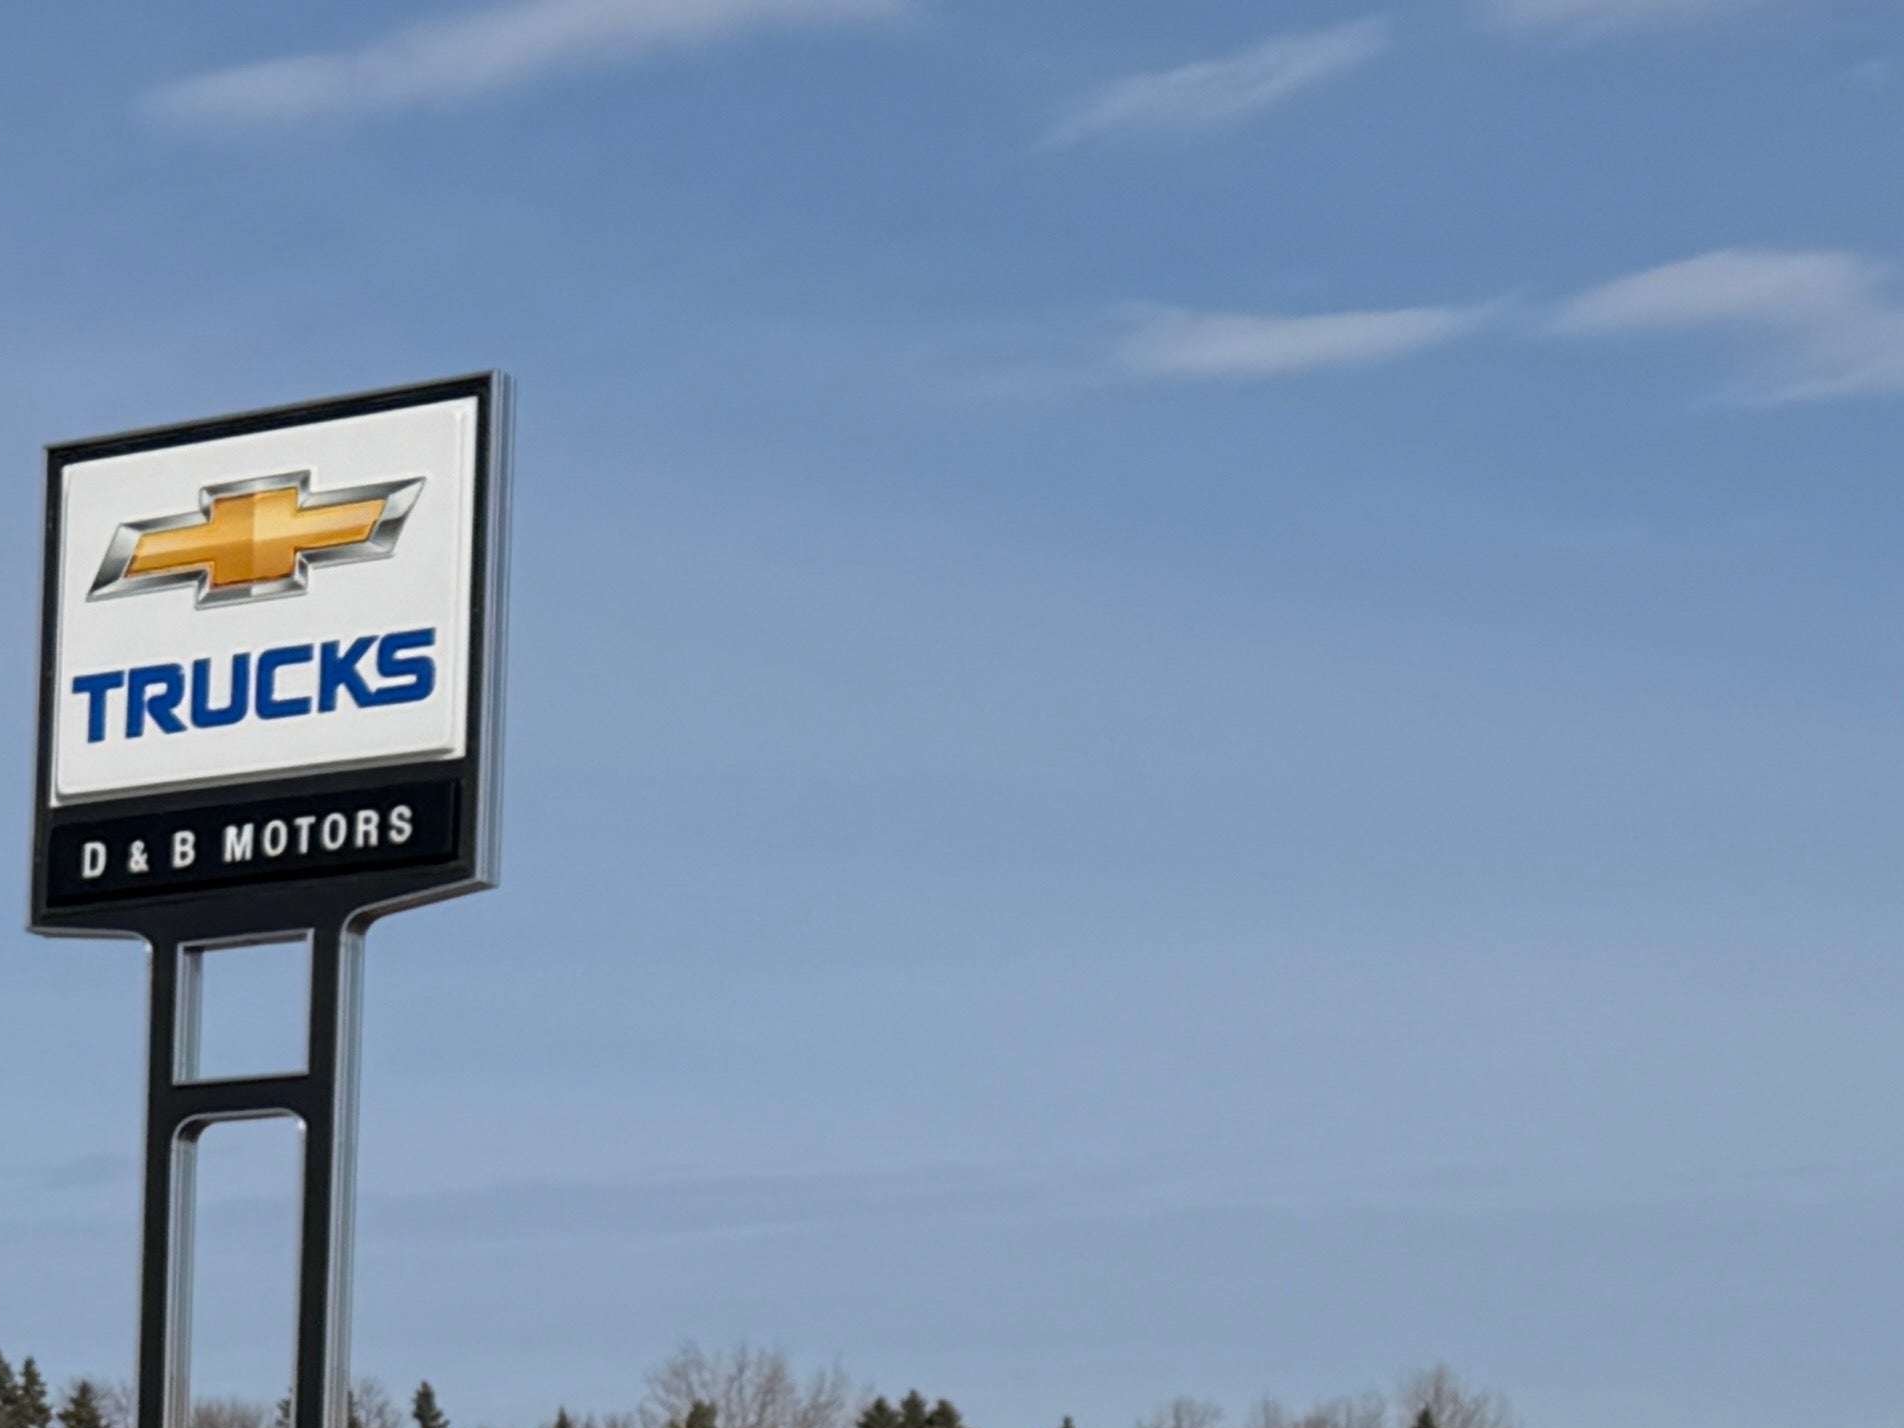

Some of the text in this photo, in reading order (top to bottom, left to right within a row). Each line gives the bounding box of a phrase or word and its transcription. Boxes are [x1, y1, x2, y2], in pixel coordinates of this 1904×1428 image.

[72, 627, 436, 743] TRUCKS
[82, 805, 414, 878] D & B MOTORS
